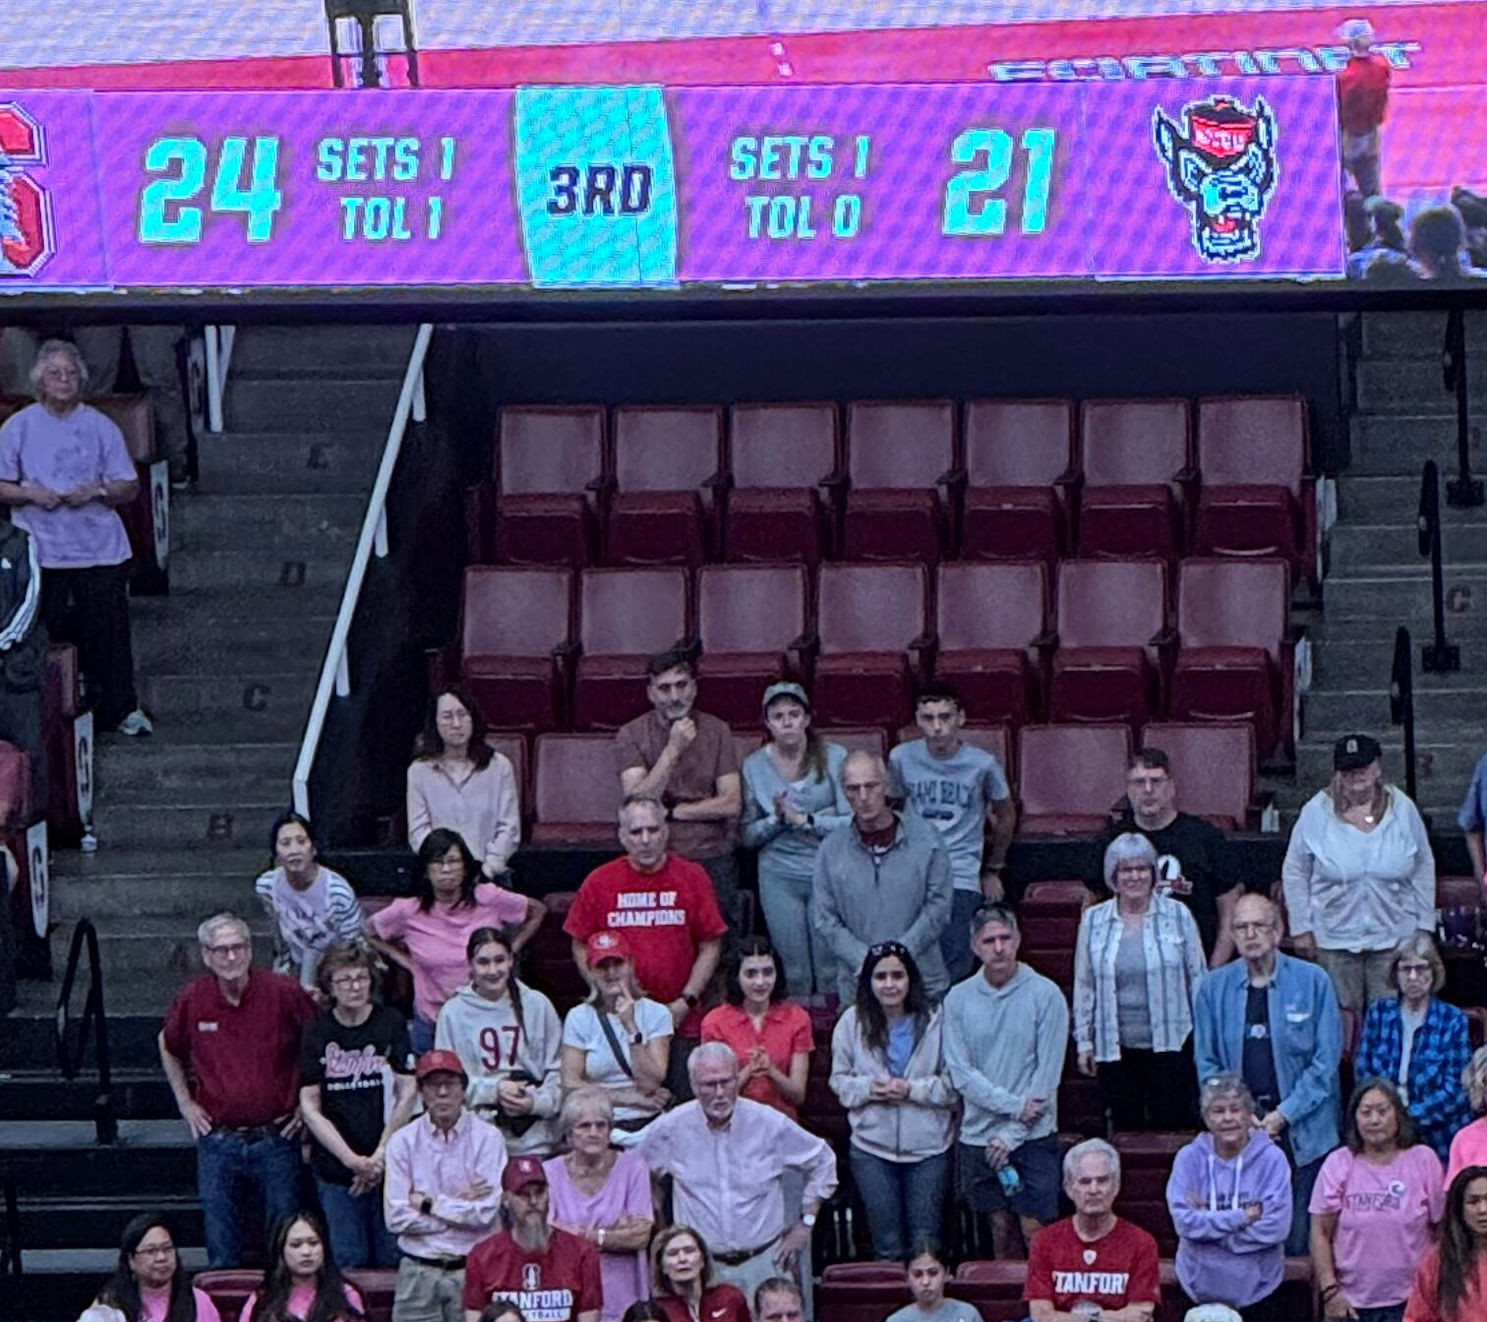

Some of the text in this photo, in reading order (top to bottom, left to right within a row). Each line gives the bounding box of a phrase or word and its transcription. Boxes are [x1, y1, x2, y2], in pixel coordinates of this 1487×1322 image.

[317, 137, 454, 181] SETS 1
[730, 136, 868, 180] SETS 1
[139, 135, 281, 242] 24
[546, 164, 653, 215] 3RD
[942, 128, 1054, 235] 21
[340, 196, 441, 240] TOL 1
[744, 195, 860, 239] TOL 0
[607, 909, 686, 927] CHAMPIONS
[617, 890, 677, 909] HOME OF
[479, 1025, 521, 1072] 97
